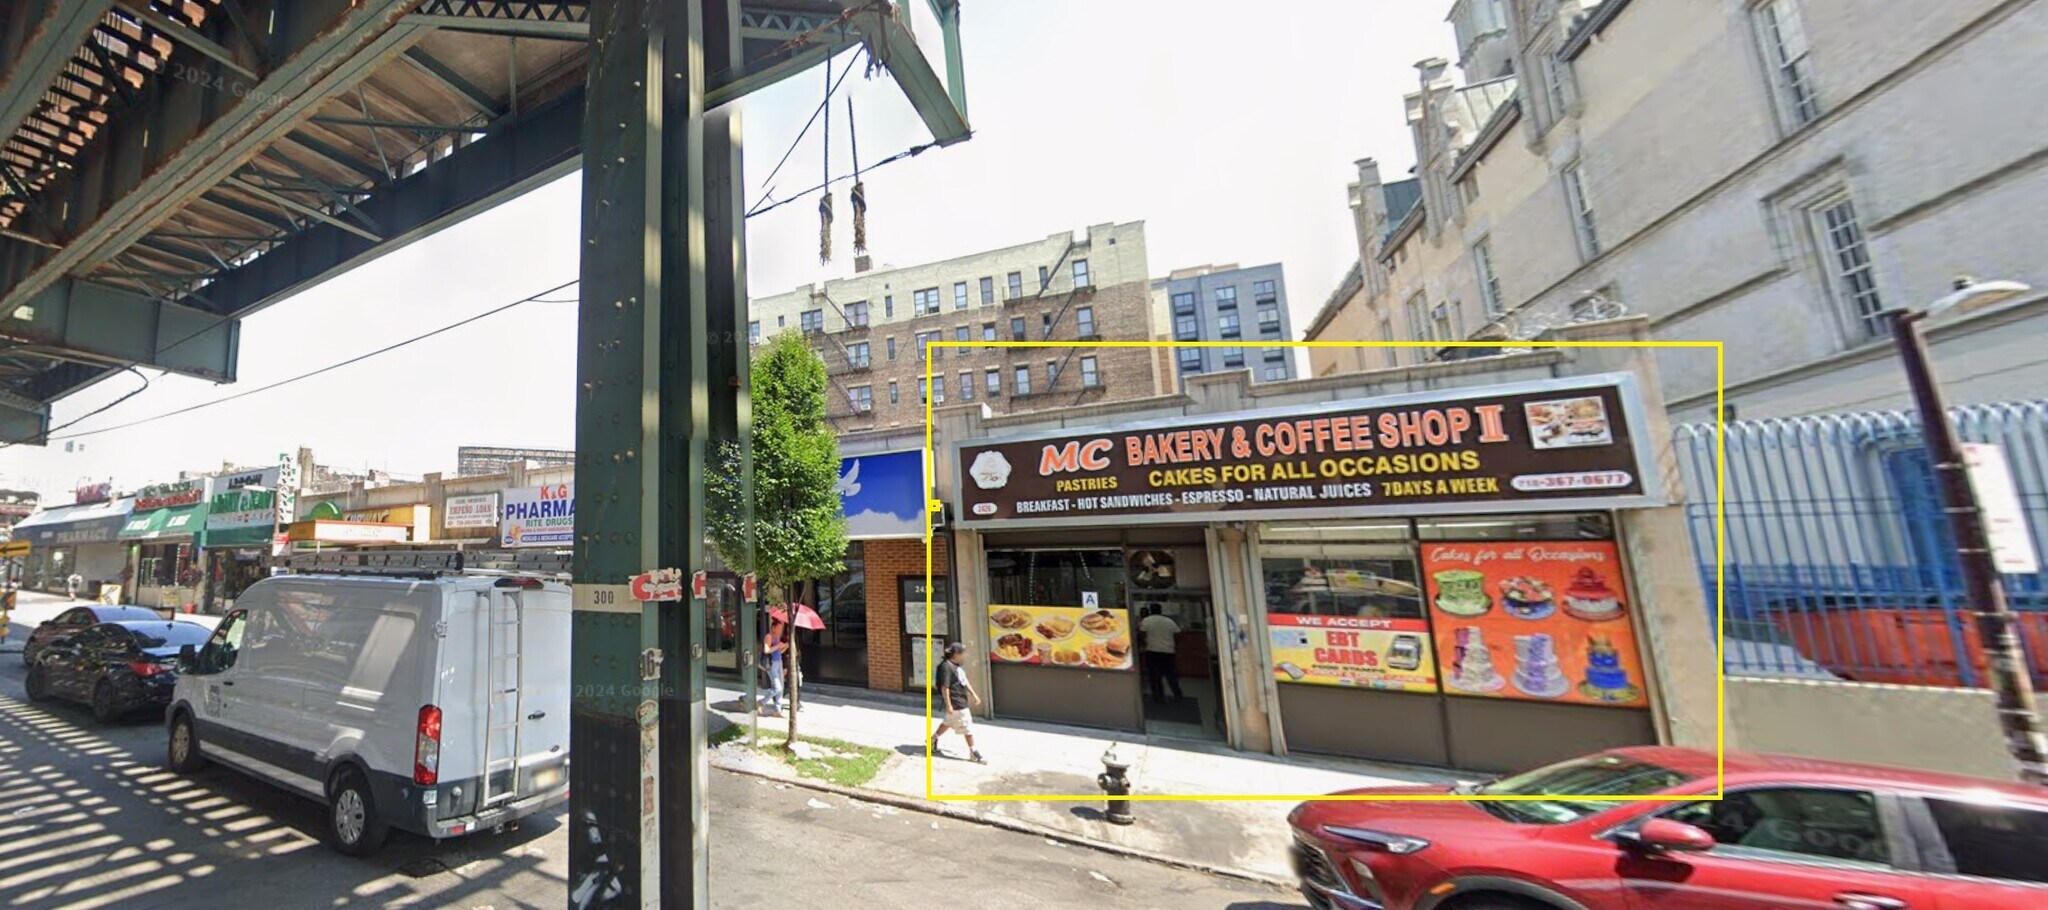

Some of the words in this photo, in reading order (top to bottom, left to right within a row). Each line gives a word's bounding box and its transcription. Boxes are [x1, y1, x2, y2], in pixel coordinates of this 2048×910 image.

[1039, 439, 1113, 476] MC
[1125, 427, 1225, 466] BAKERY
[1231, 425, 1252, 458] &
[1255, 414, 1374, 456] COFFEE
[1377, 407, 1471, 448] SHOP
[1149, 464, 1216, 487] CAKES
[1222, 463, 1266, 484] FOR
[1271, 458, 1315, 481] ALL
[1320, 450, 1480, 478] OCCASIONS
[1056, 476, 1118, 492] PASTRIES
[1382, 480, 1434, 497] 7DAYS
[1436, 480, 1448, 495] A
[1449, 477, 1499, 494] WEEK
[1016, 500, 1070, 514] BREAKFAST
[1077, 497, 1099, 510] HOT
[1100, 492, 1173, 509] SANDWICHES
[1182, 489, 1244, 505] ESPRESSO
[1253, 484, 1316, 501] NATURAL
[1319, 482, 1372, 499] JUICES
[526, 518, 542, 528] RITE
[546, 516, 573, 526] DRUGS
[1430, 546, 1471, 564] Cakes
[1474, 547, 1497, 566] for
[1503, 547, 1524, 562] all
[1528, 547, 1605, 563] Occasions
[594, 591, 614, 605] 300
[1086, 594, 1095, 604] A
[1296, 616, 1322, 626] WE
[1327, 617, 1392, 628] ACCEPT
[1325, 631, 1360, 647] EBT
[1314, 648, 1378, 667] CARDS
